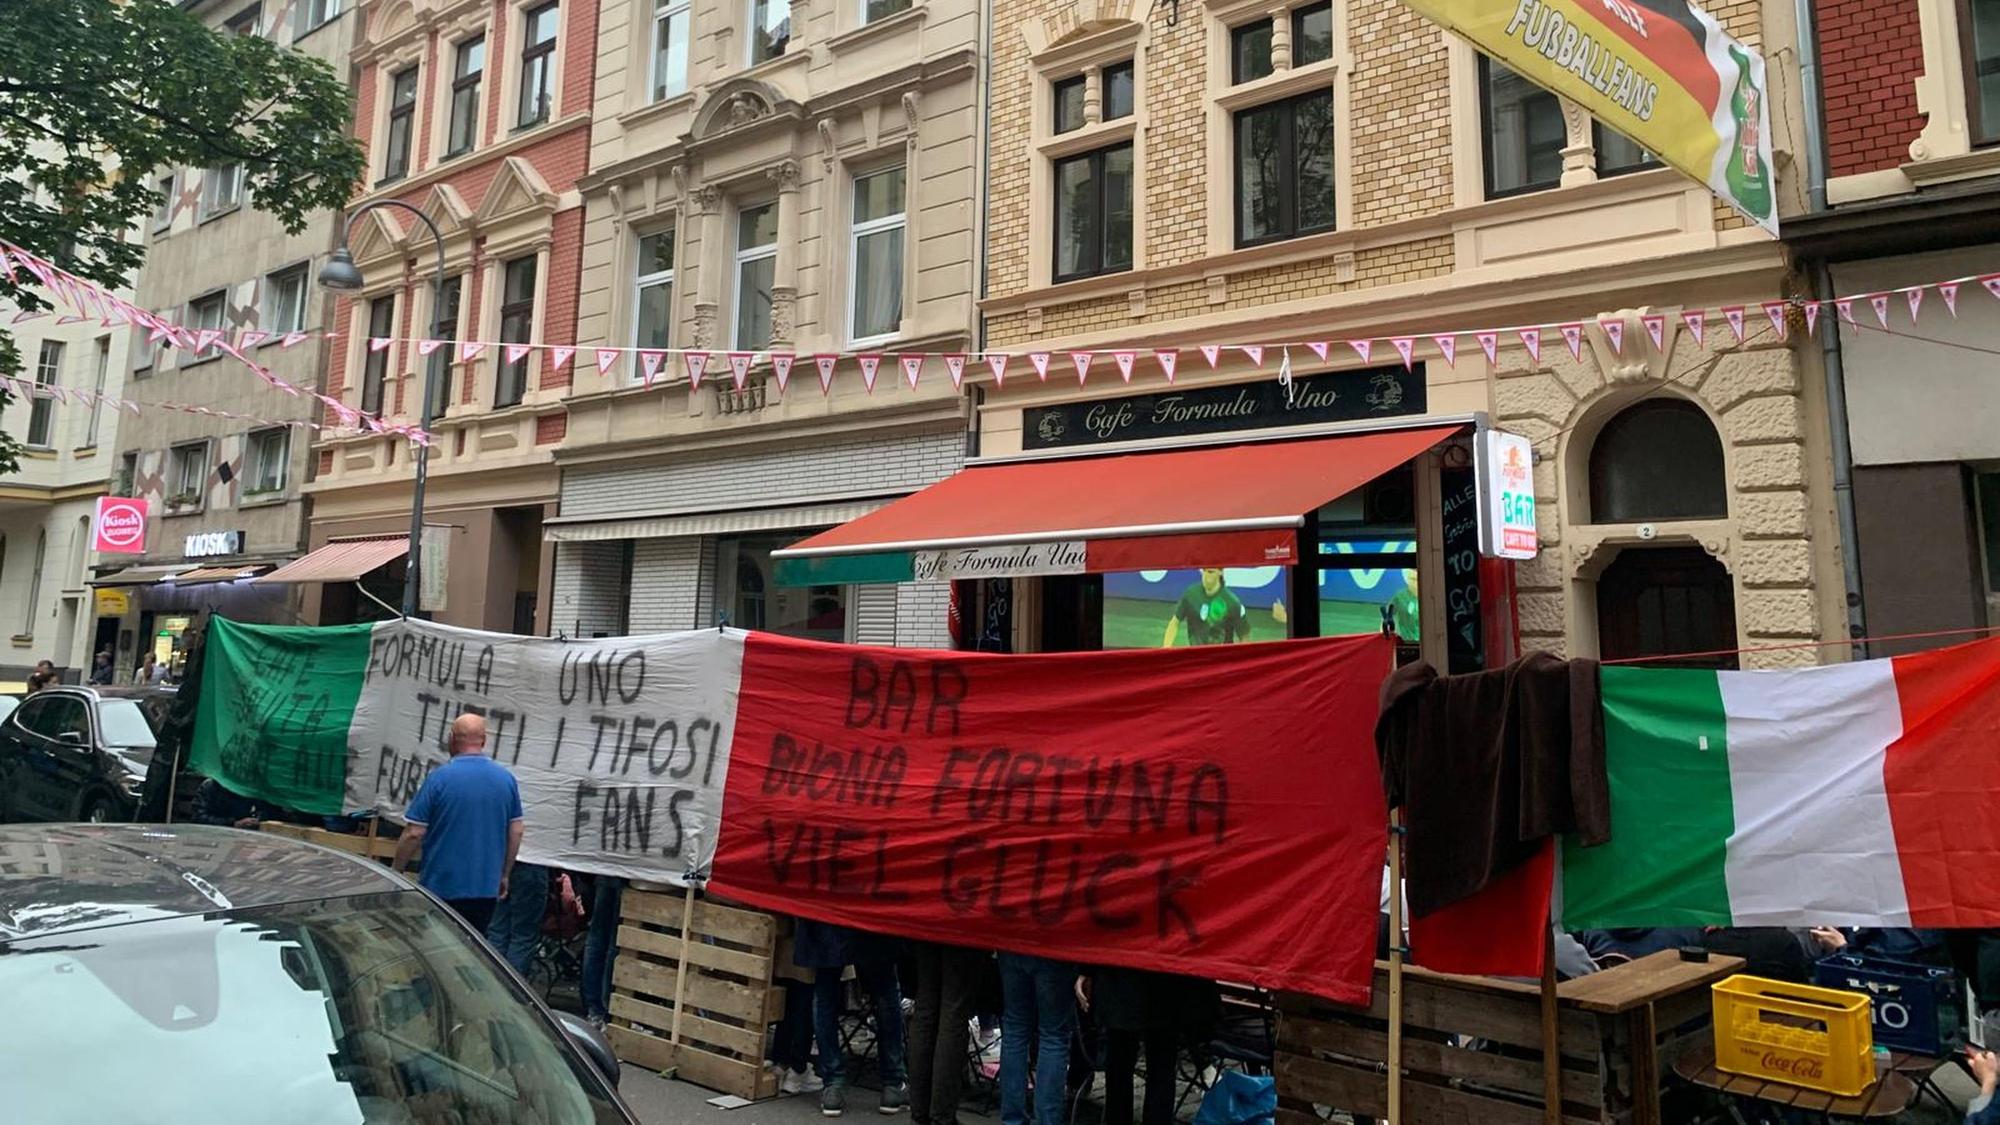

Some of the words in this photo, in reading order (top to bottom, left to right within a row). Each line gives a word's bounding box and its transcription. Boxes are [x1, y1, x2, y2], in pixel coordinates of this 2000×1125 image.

[1152, 389, 1257, 425] Formula
[1282, 381, 1340, 411] Uno
[104, 514, 138, 527] Kiosk
[185, 533, 230, 557] KIOSK
[953, 546, 1037, 571] Formula
[1049, 541, 1088, 565] Uno
[1643, 527, 1650, 537] 2
[367, 633, 495, 696] FORMULA
[560, 650, 645, 706] UNO
[846, 654, 968, 736] BAR
[551, 717, 565, 768] I
[588, 714, 720, 785] TIFOSI
[573, 783, 694, 858] FANS
[762, 733, 908, 808] BUONA
[931, 746, 1230, 844] FORTUNA
[763, 819, 908, 900] VIEL
